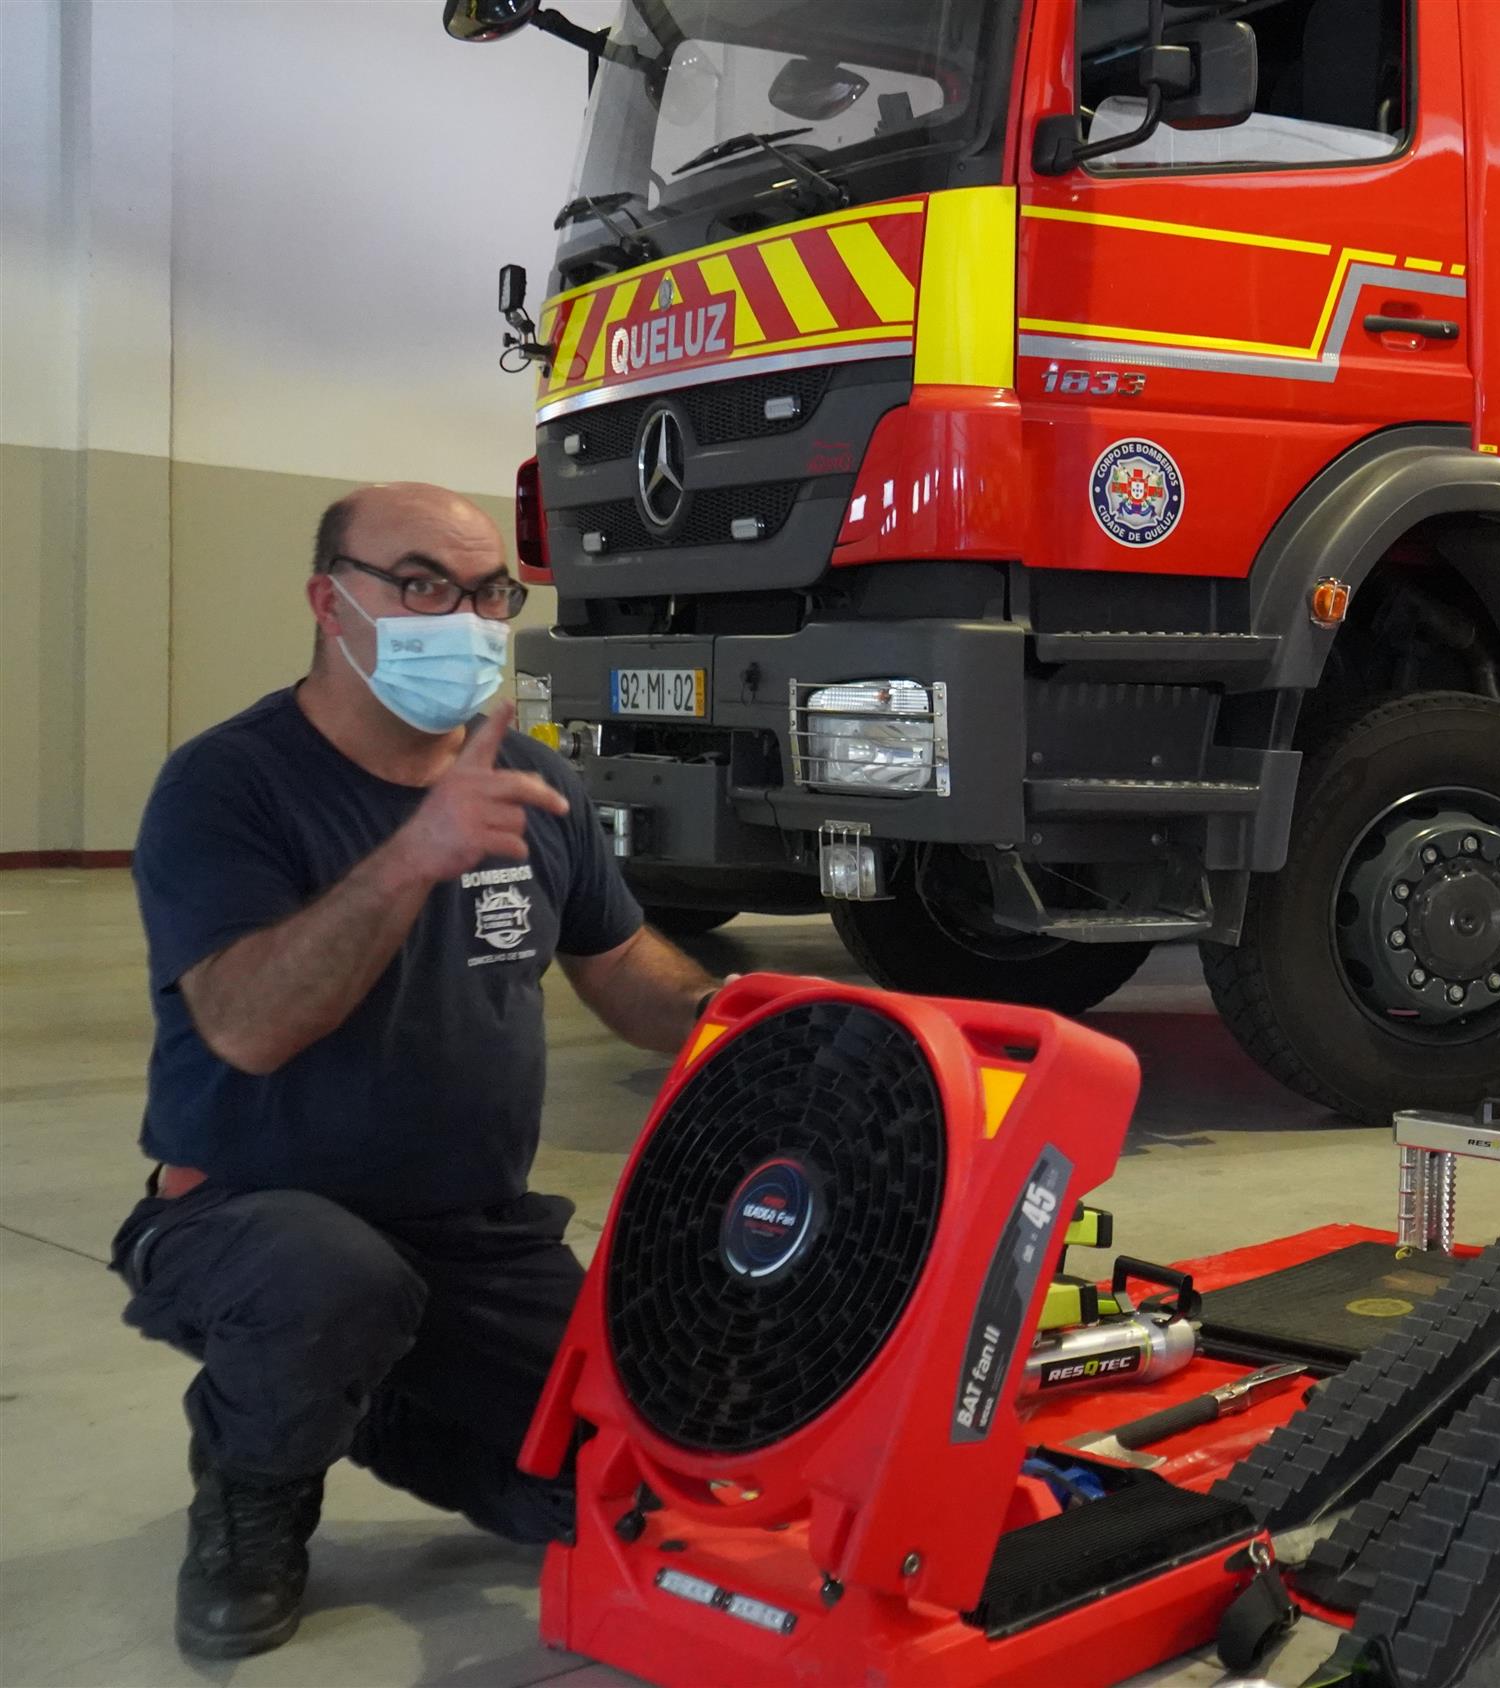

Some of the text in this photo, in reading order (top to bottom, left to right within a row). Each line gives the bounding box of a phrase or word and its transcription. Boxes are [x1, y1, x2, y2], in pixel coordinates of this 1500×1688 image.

[611, 303, 727, 375] QUELUZ
[1041, 361, 1147, 395] 1833
[1096, 443, 1179, 487] CORPO DE BOMBEIROS
[1097, 504, 1176, 542] CIDADE DE QUELUZ
[1021, 1181, 1058, 1231] 45
[956, 1381, 983, 1429] BAT
[971, 1345, 993, 1382] fan
[1047, 1355, 1133, 1382] RESQTEC
